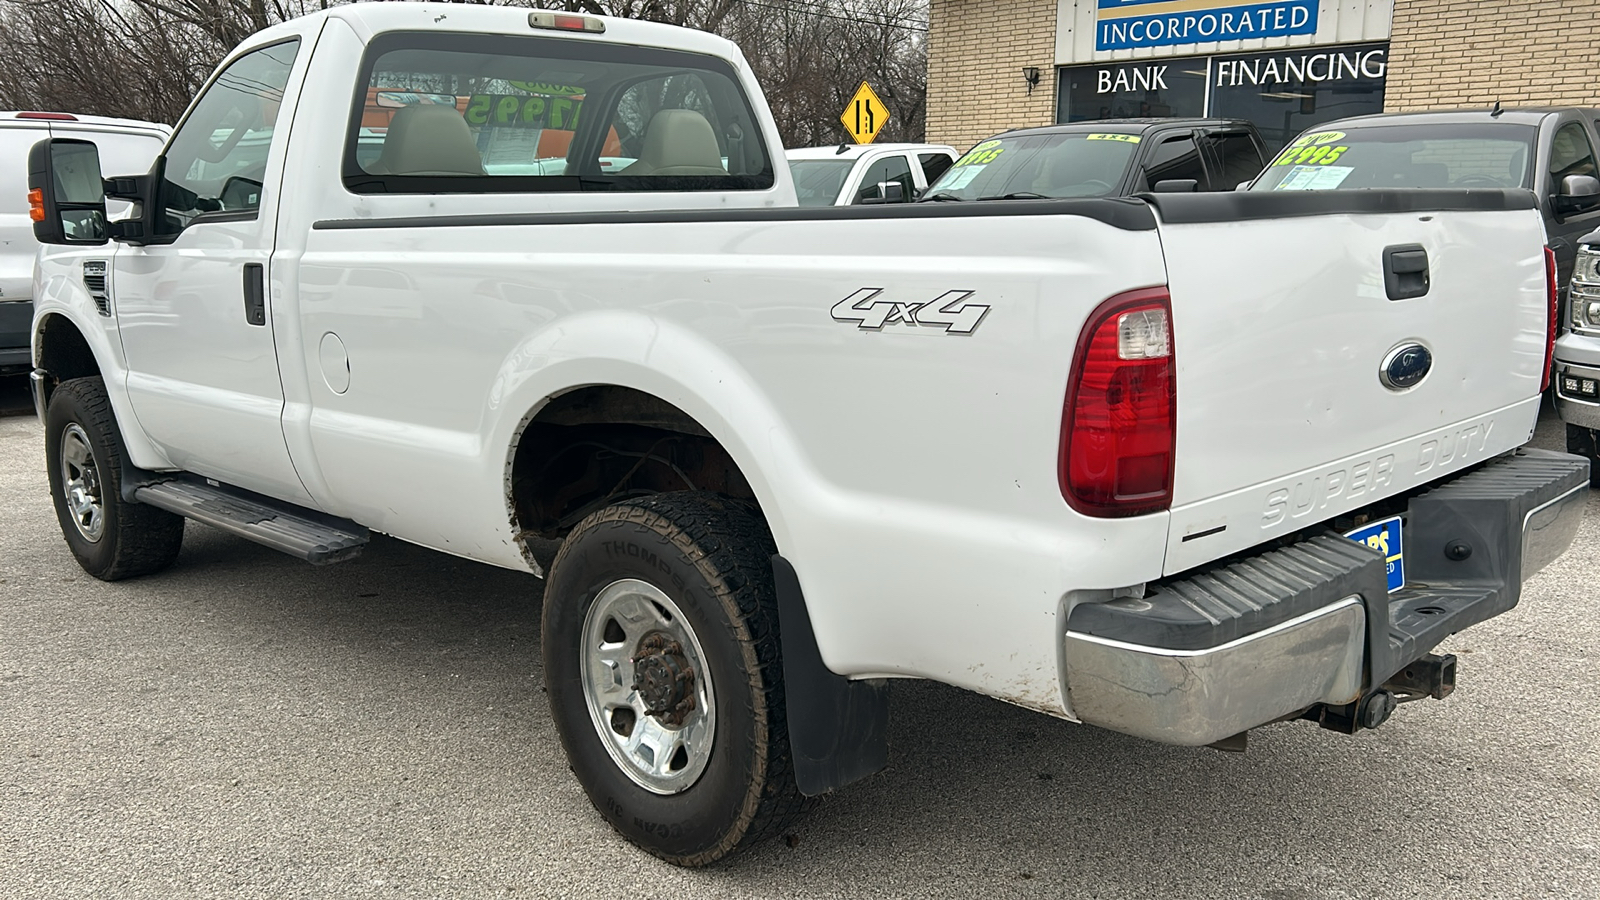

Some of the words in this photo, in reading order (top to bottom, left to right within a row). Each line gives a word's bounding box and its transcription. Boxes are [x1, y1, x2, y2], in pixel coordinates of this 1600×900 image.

[1102, 6, 1309, 44] INCORPORATED
[1096, 66, 1169, 94] BANK
[1216, 50, 1385, 87] FINANCING
[1260, 452, 1395, 530] SUPER
[1413, 420, 1494, 476] DUTY
